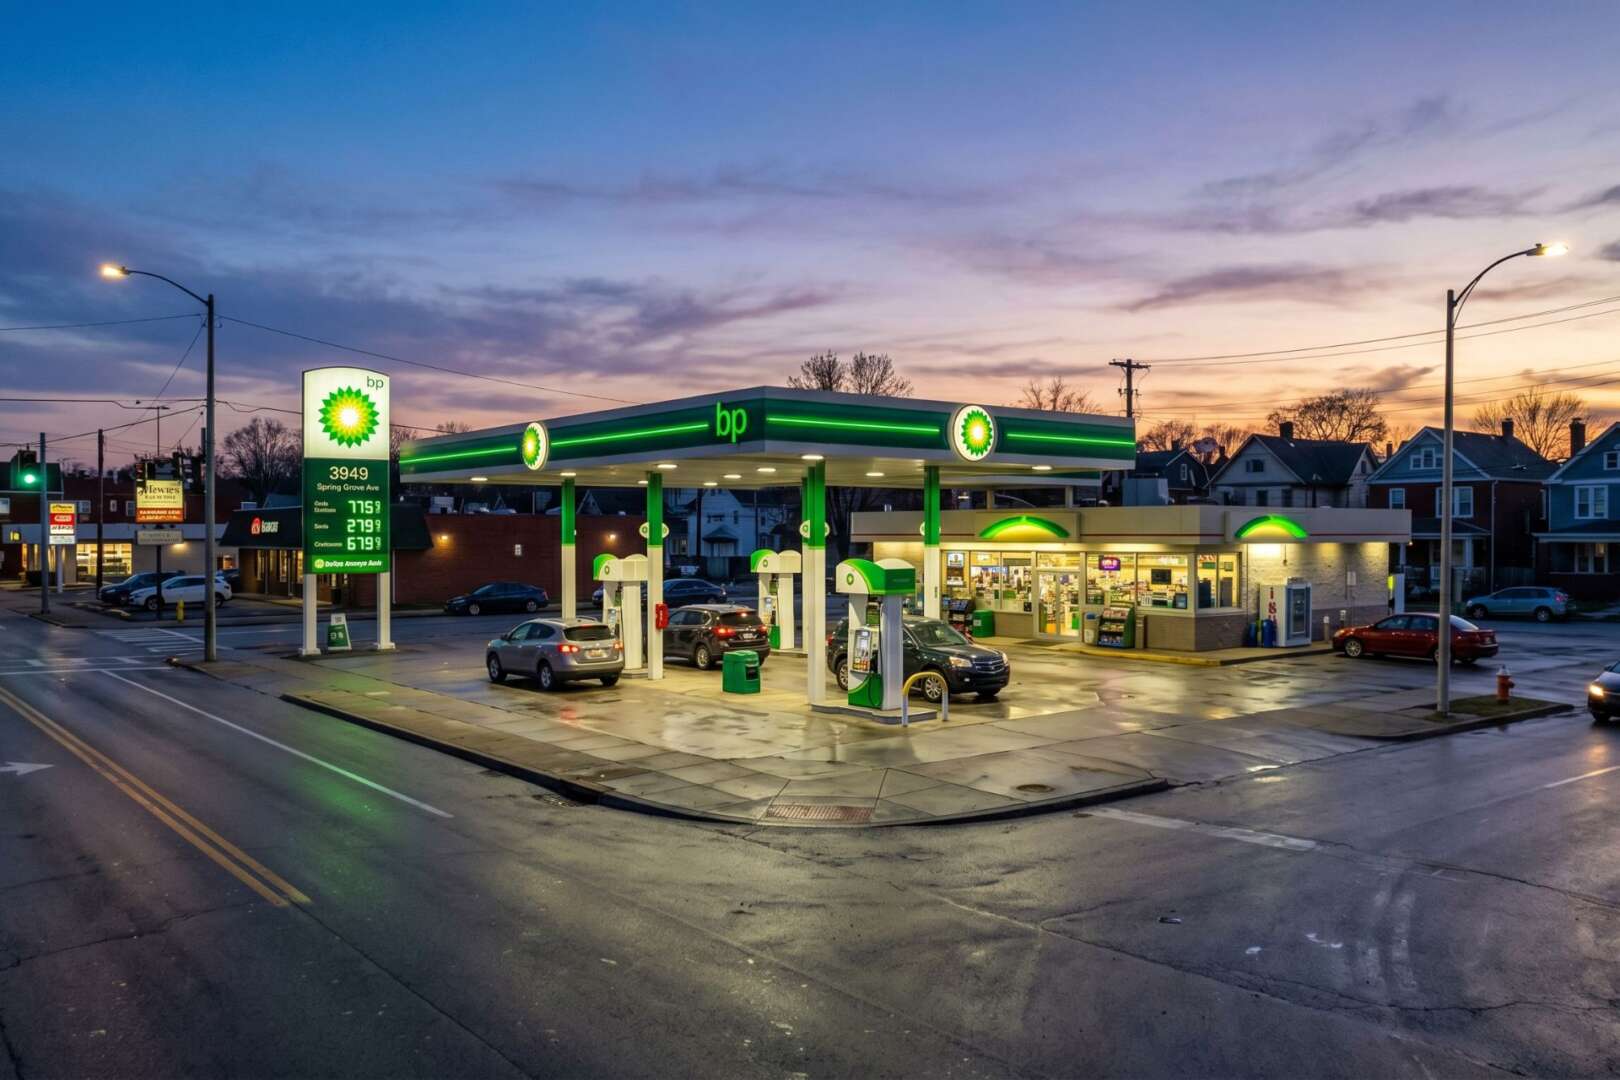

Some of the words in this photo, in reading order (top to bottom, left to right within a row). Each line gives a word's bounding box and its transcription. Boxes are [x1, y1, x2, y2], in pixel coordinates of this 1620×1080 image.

[366, 375, 384, 390] bp
[716, 401, 747, 443] bp
[329, 466, 369, 480] 3949
[316, 482, 342, 492] Spring
[343, 483, 365, 491] Grove
